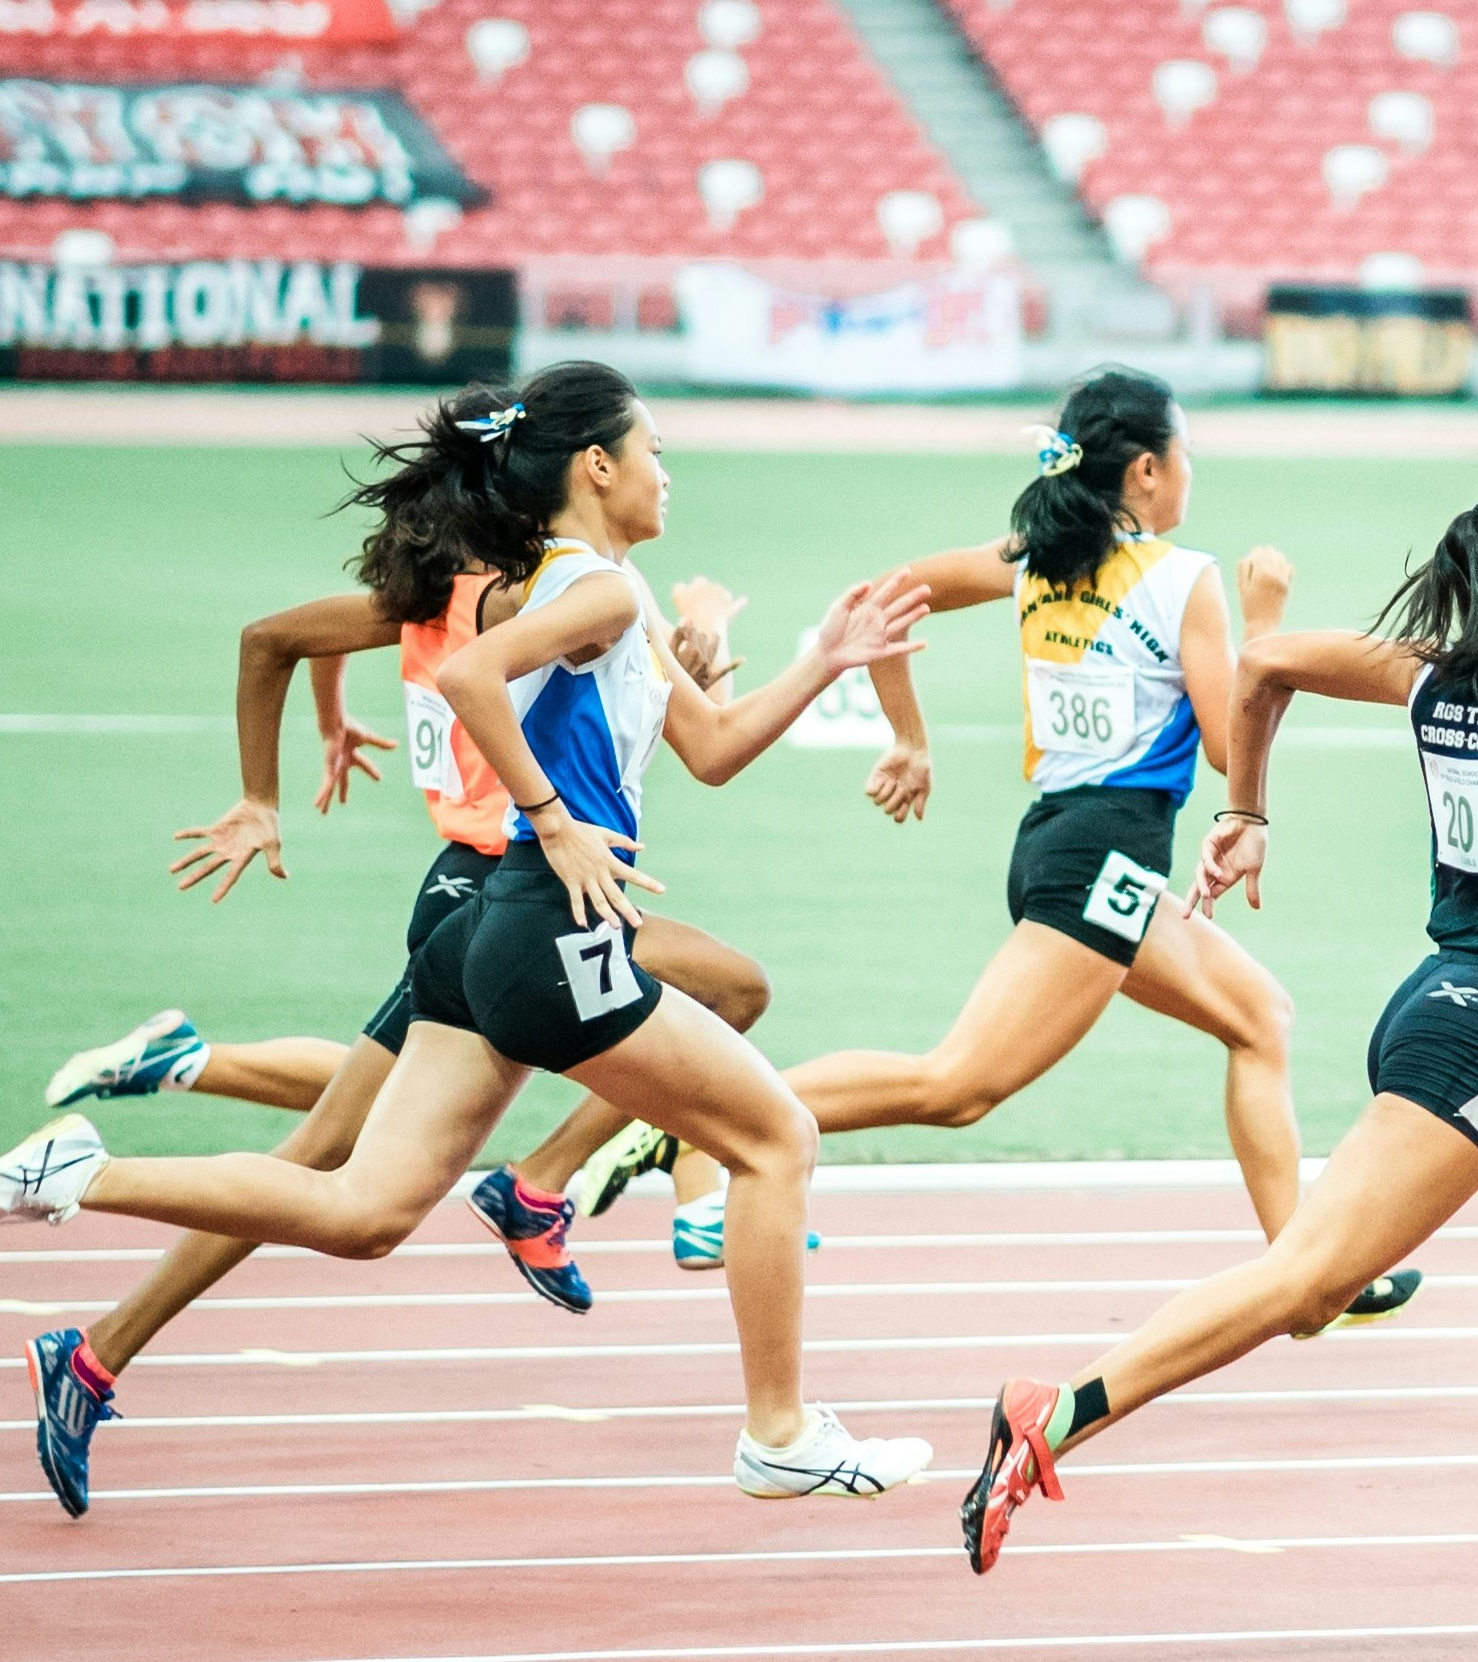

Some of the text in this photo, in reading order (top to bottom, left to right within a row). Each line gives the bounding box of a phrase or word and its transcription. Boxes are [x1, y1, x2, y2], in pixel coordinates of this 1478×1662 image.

[0, 261, 381, 350] NATIONAL
[1044, 630, 1114, 656] ATHLETICS
[1129, 619, 1169, 663] HIGH
[1050, 690, 1112, 742] 386
[1432, 701, 1464, 722] RGS
[1107, 873, 1147, 916] 5
[579, 939, 613, 995] 7
